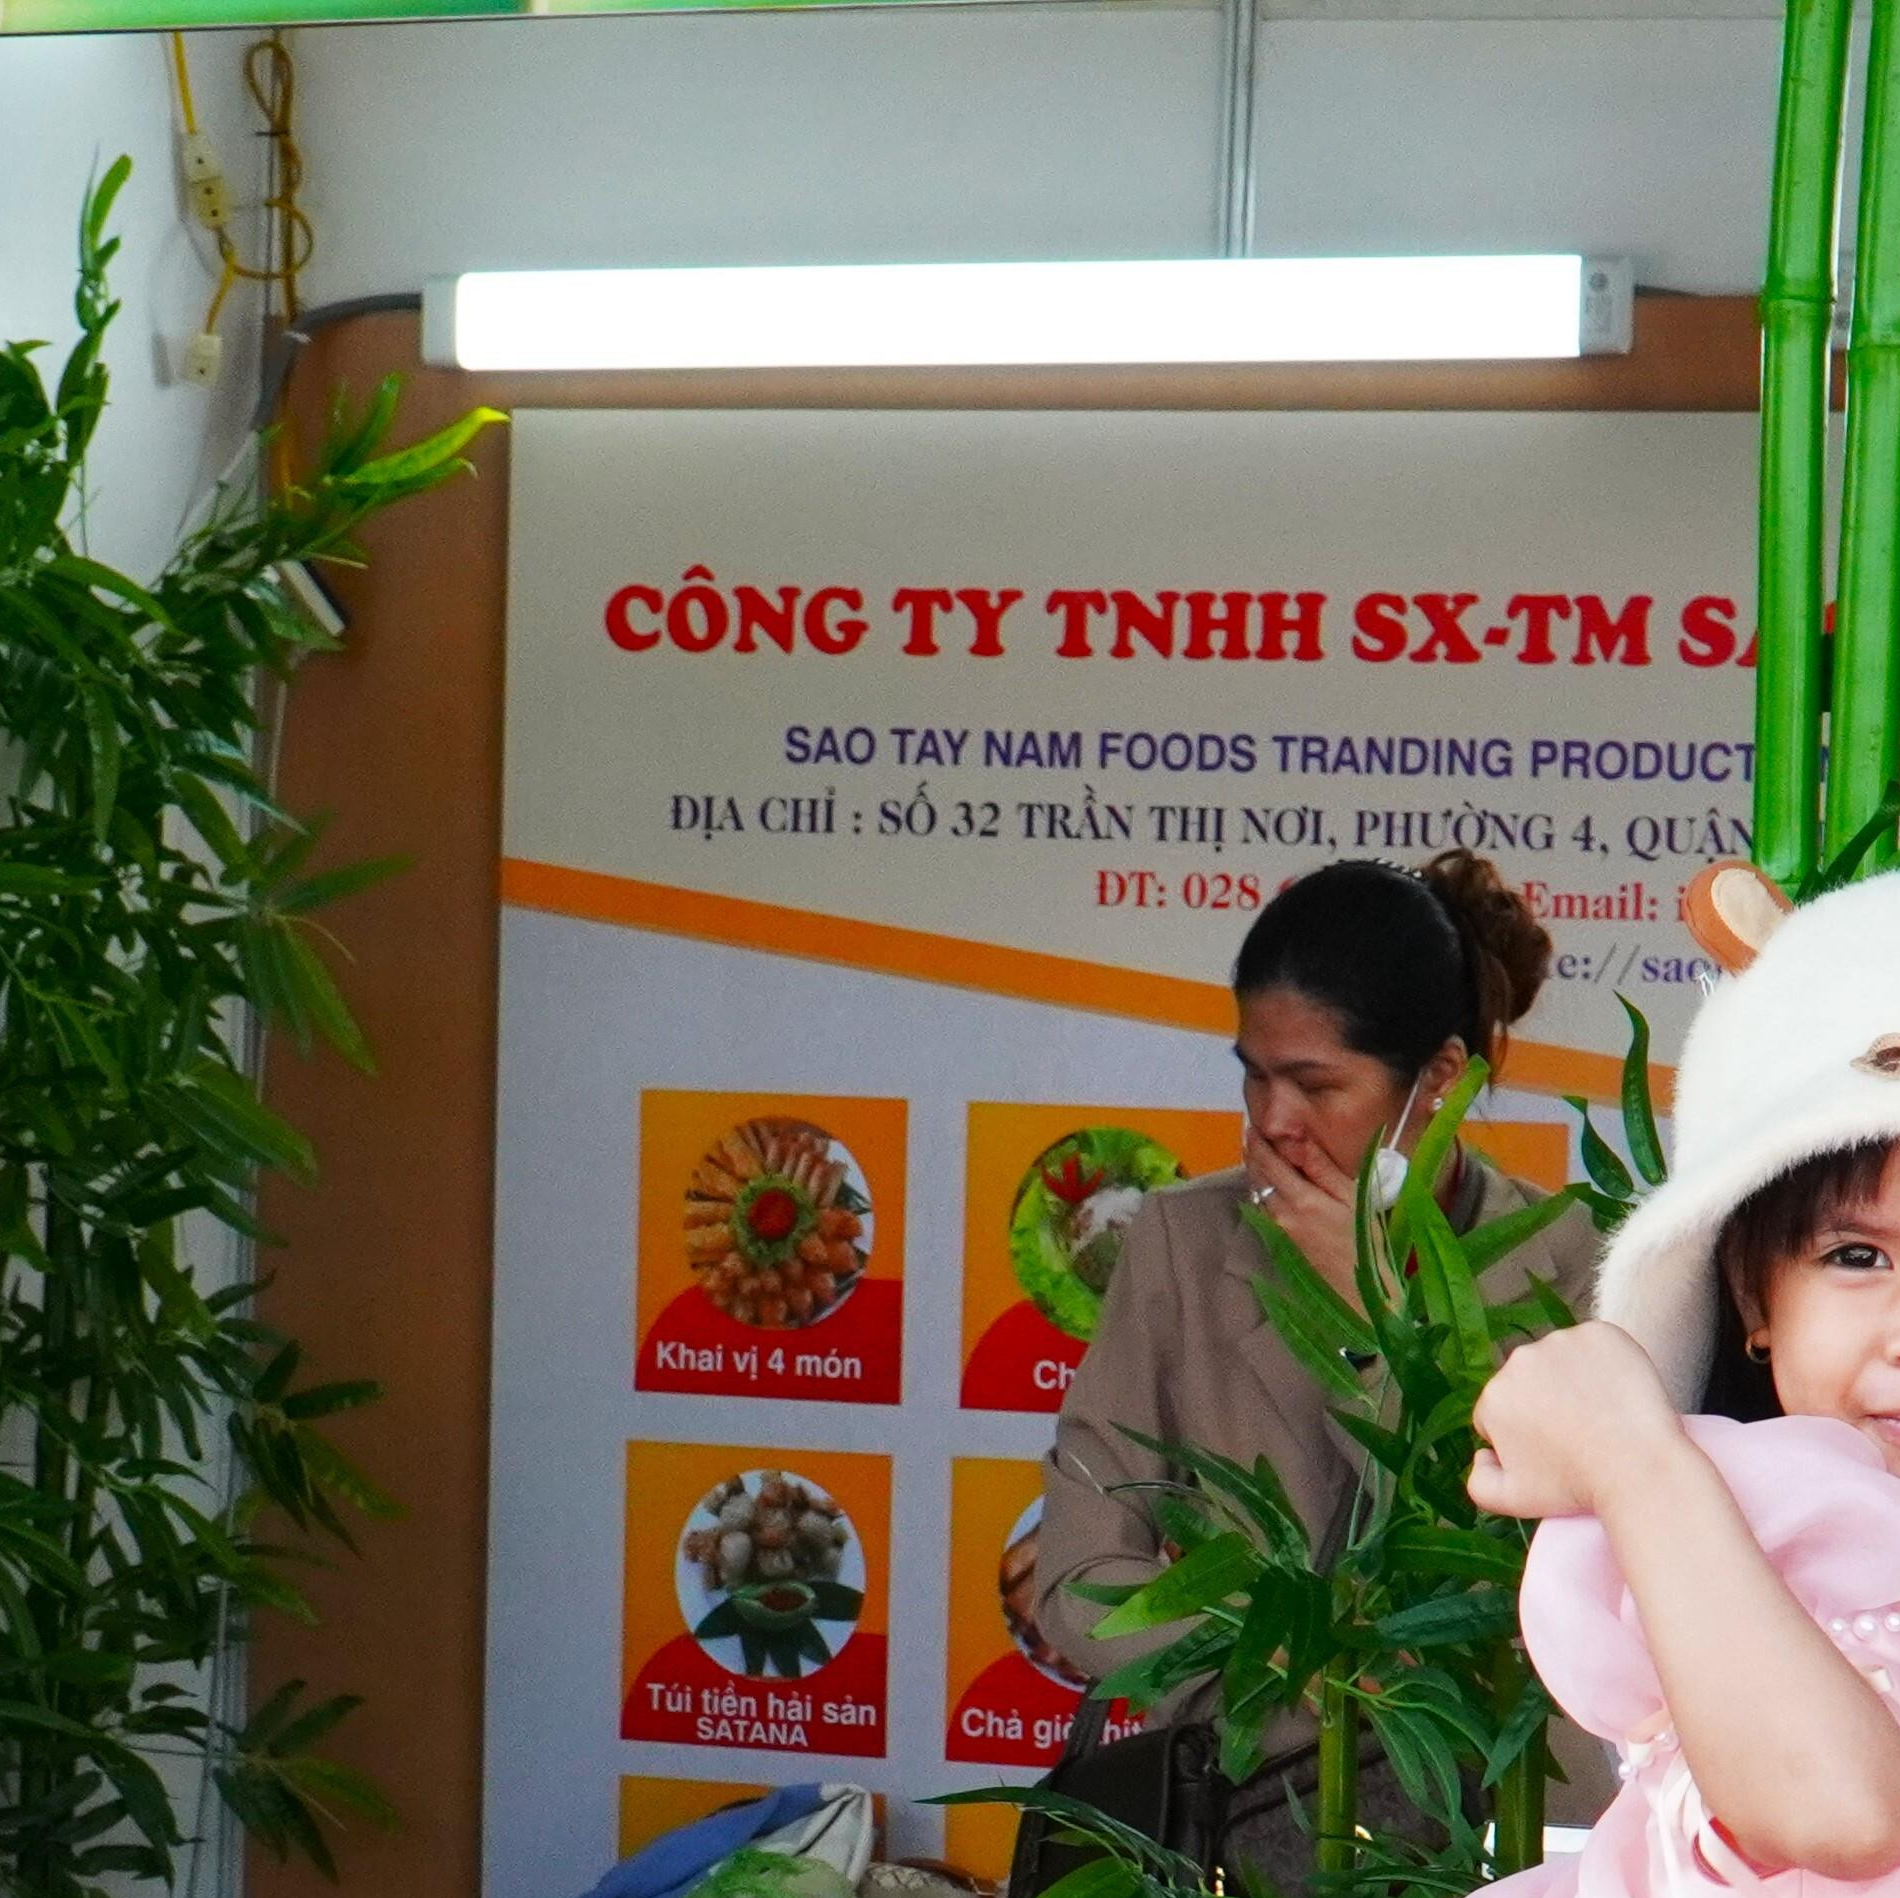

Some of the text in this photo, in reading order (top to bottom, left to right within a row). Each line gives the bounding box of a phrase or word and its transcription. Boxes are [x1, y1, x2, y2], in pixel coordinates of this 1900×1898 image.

[604, 563, 870, 657] CÔNG
[892, 586, 1024, 659] TY
[1046, 587, 1329, 664] TNHH
[1351, 592, 1654, 669] SX-TM
[784, 724, 1756, 784] SAO TAY NAM FOODS TRANDING PRODUCT
[668, 792, 745, 842] ĐỊA
[757, 784, 837, 835] CHỈ
[877, 780, 938, 837] SỐ
[950, 800, 1002, 839] 32
[1015, 783, 1136, 841] TRẦN
[1148, 804, 1226, 854] THỊ
[1240, 804, 1338, 854] NƠI,
[1354, 801, 1555, 853] PHƯỜNG
[1572, 814, 1609, 855] 4,
[1182, 871, 1262, 911] 028
[1521, 881, 1657, 922] Email:
[655, 1340, 862, 1381] Khai vị 4 món
[1032, 1359, 1078, 1390] Ch
[646, 1682, 693, 1714] Túi
[700, 1679, 757, 1717] tiền
[696, 1716, 809, 1748] SATANA
